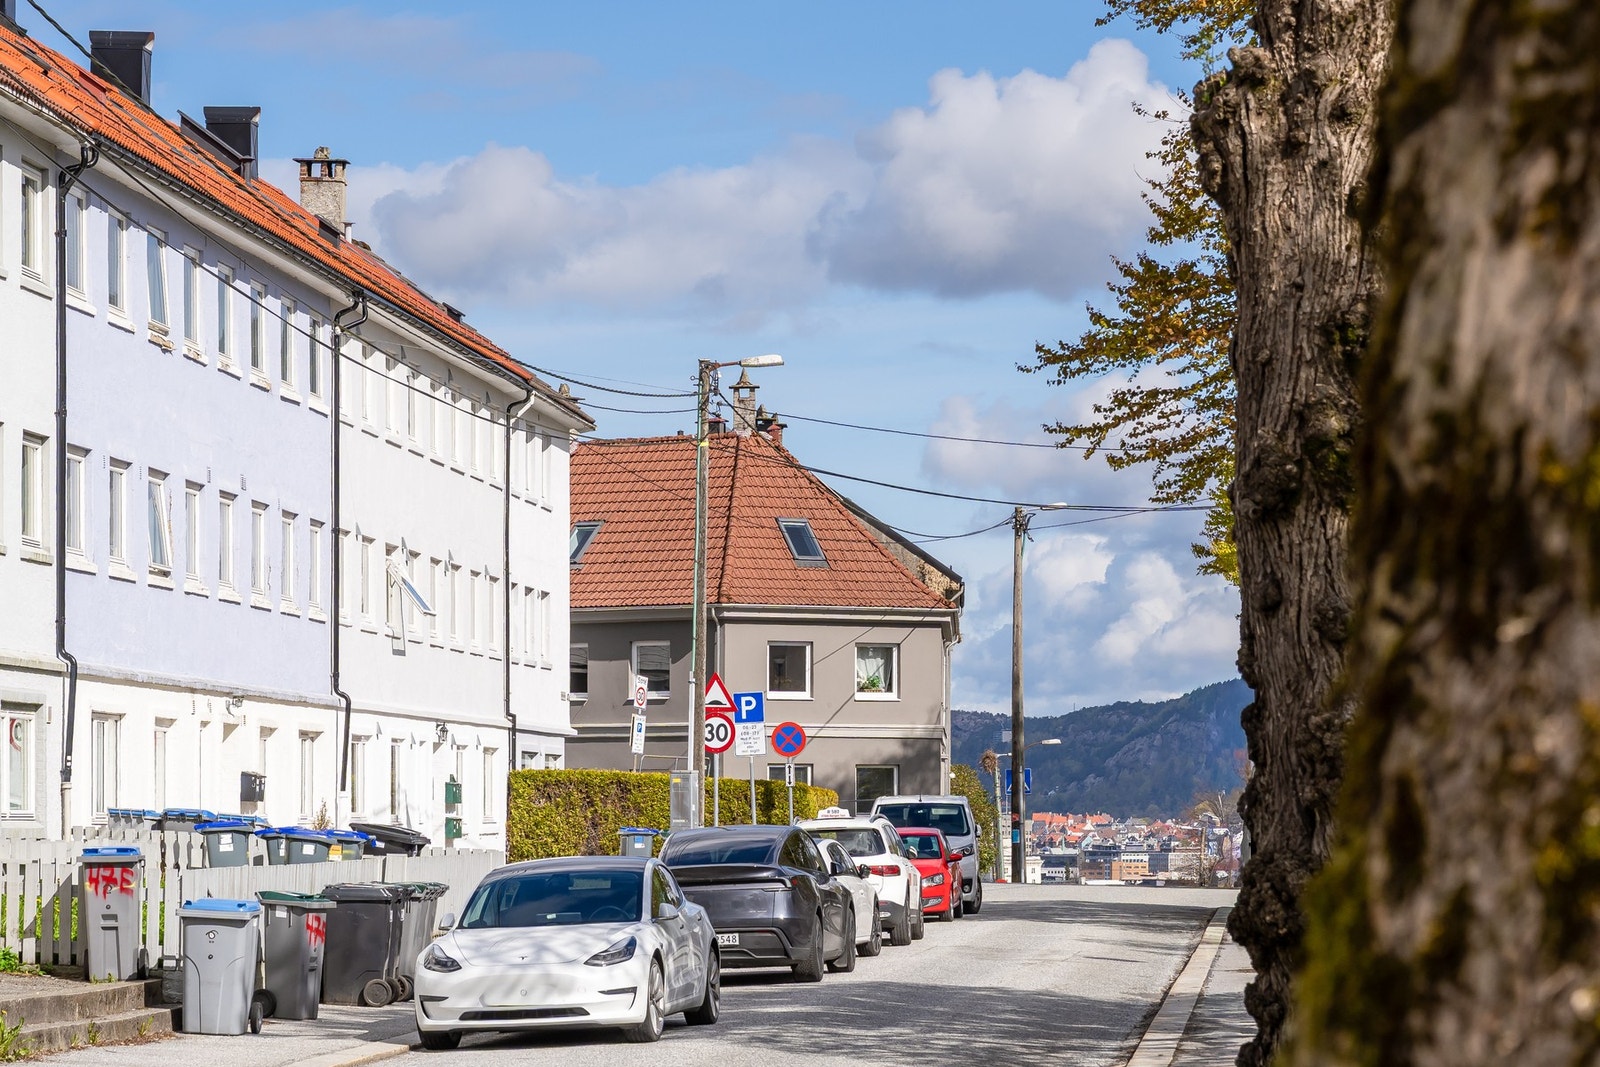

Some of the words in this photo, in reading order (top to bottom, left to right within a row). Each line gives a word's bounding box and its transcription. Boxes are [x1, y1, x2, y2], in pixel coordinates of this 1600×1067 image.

[638, 691, 644, 701] 30
[741, 696, 757, 720] P
[705, 723, 729, 742] 30
